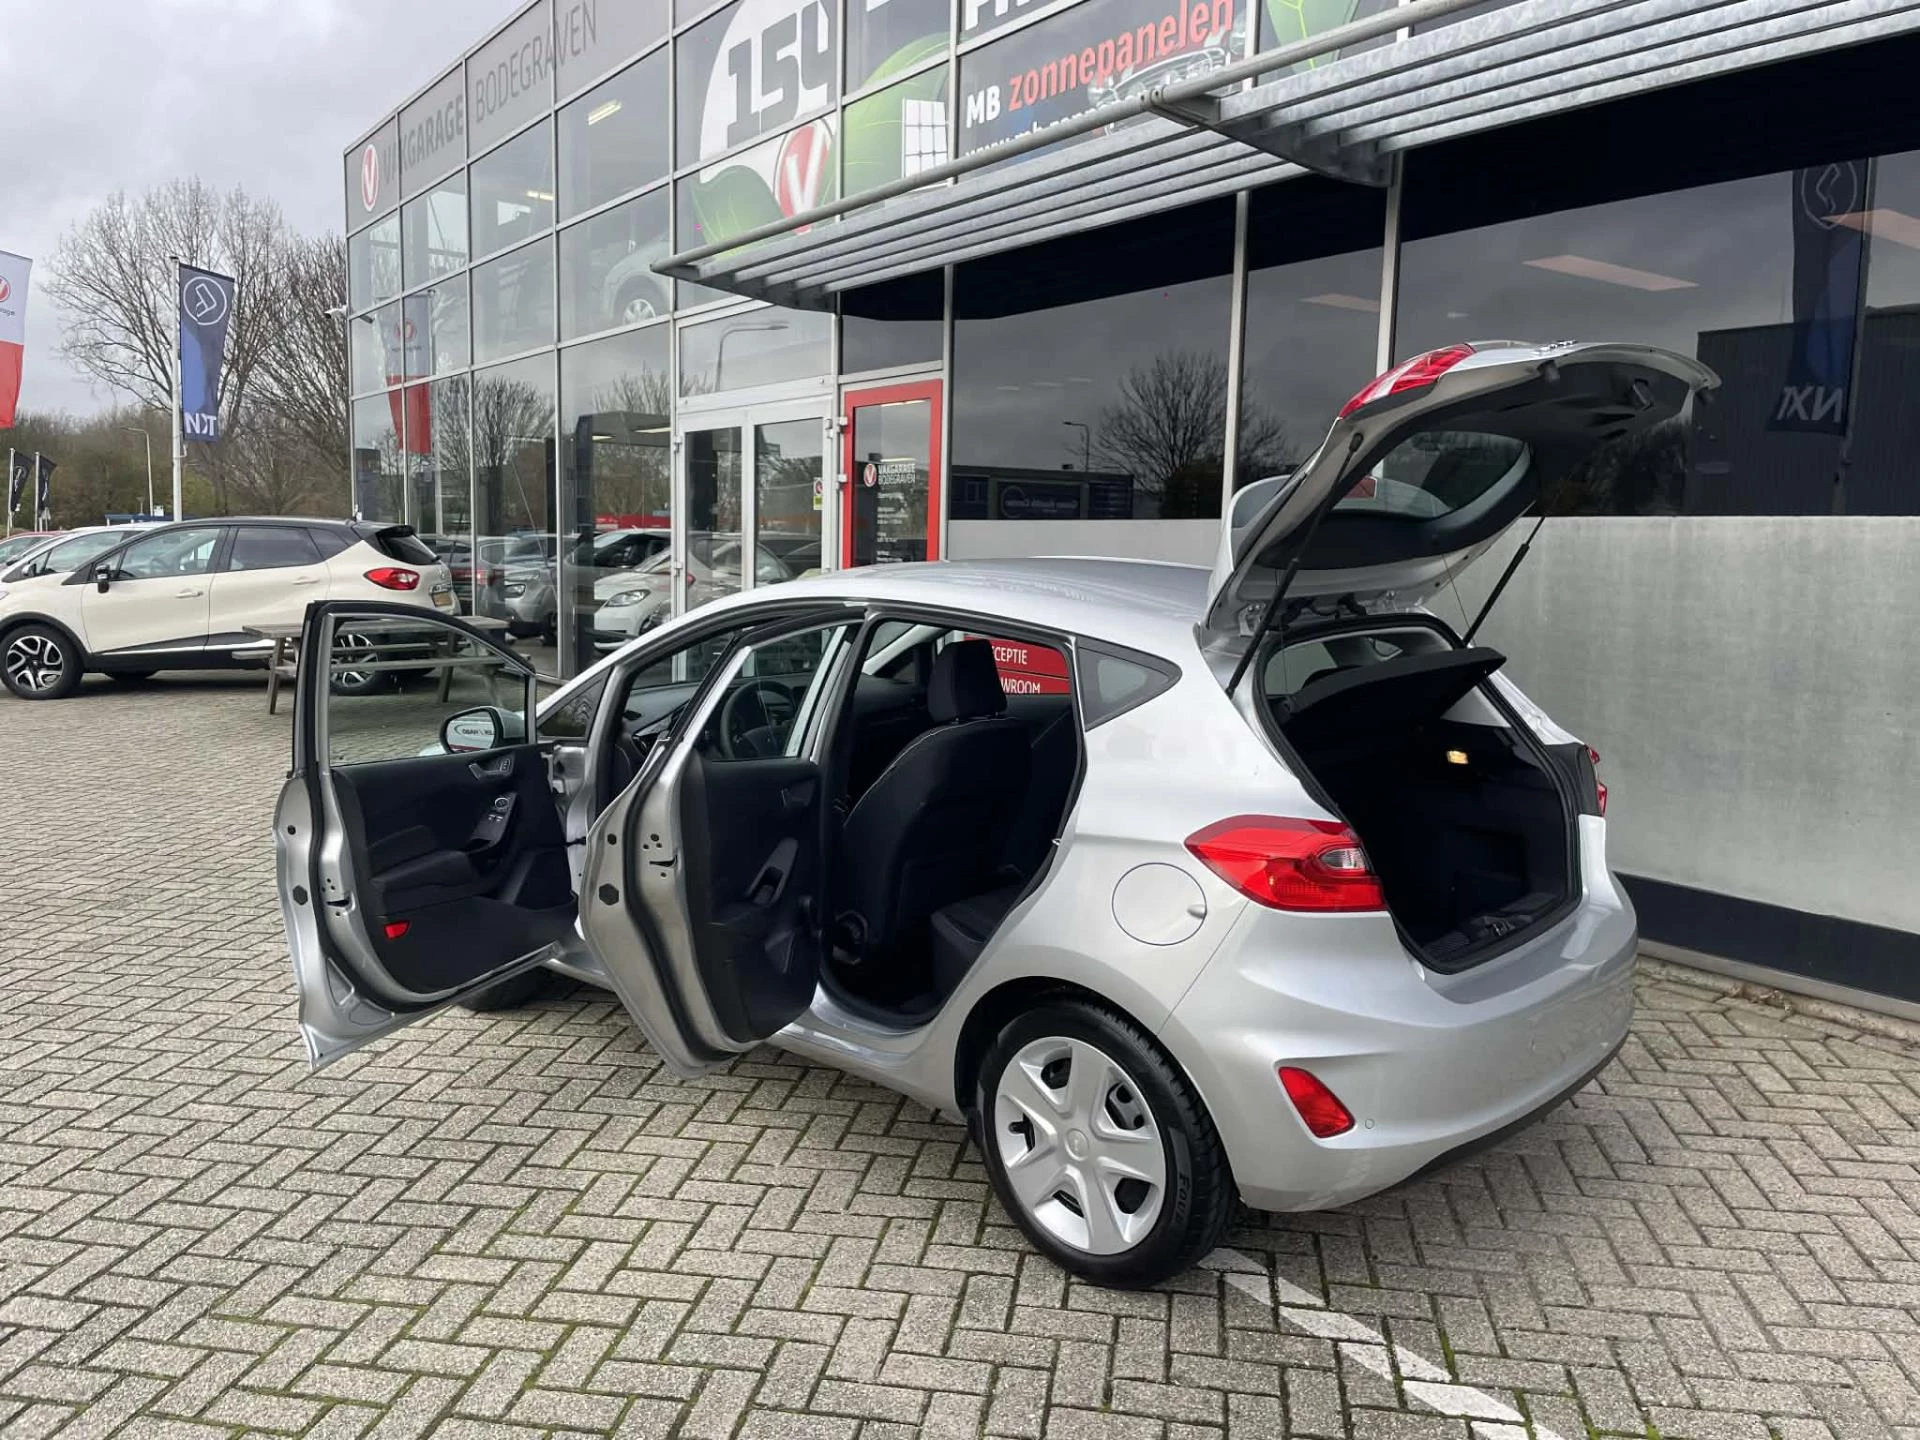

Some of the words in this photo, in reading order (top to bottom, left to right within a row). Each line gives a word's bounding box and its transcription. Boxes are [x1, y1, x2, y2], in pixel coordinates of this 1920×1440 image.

[475, 0, 597, 123] BODEGRAVEN
[728, 0, 837, 149] 154
[966, 84, 1001, 128] MB
[1008, 0, 1234, 112] zonnepanelen
[992, 645, 1028, 665] CEPTIE
[1001, 677, 1041, 694] WROOM
